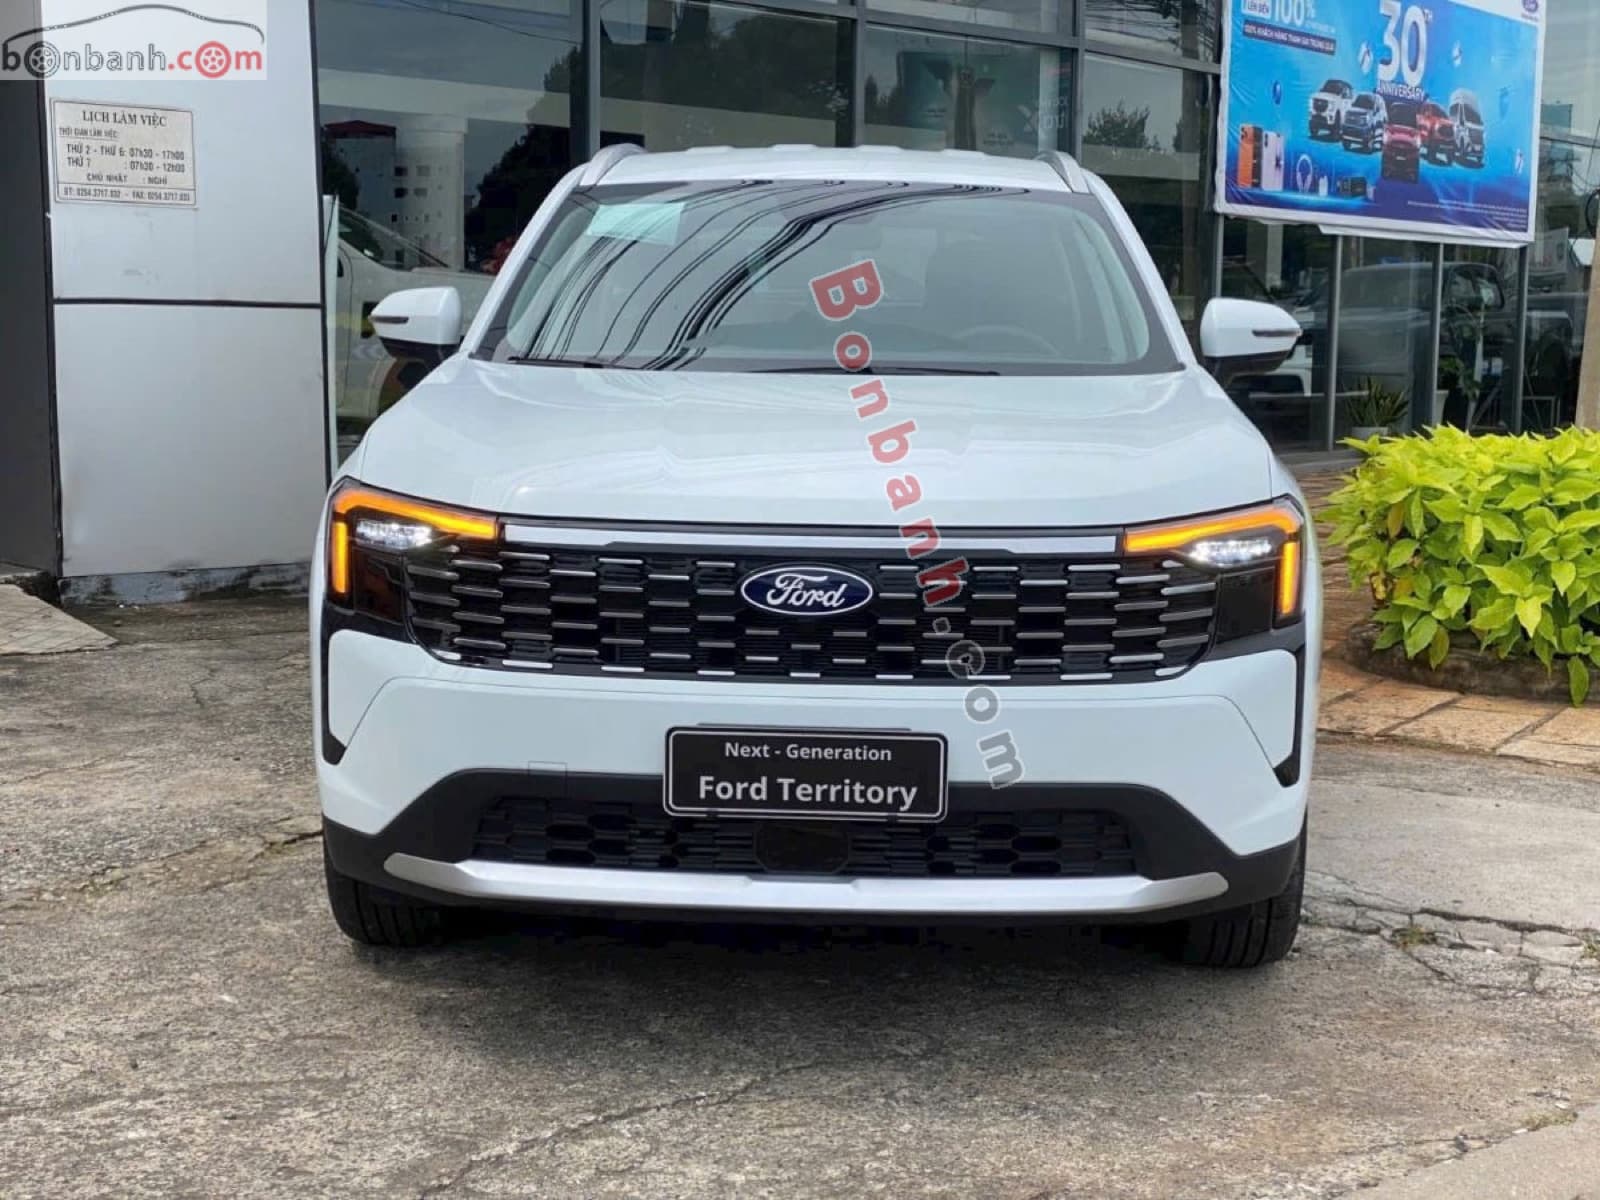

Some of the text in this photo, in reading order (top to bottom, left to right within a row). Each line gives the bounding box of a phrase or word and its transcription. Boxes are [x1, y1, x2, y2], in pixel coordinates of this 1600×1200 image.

[82, 110, 167, 128] LỊCH LÀM VIỆC
[67, 142, 84, 154] THỨ
[86, 144, 91, 156] 2
[100, 144, 116, 157] THỨ
[765, 572, 846, 609] Ford
[724, 741, 771, 759] Next
[785, 742, 893, 762] Generation
[698, 775, 919, 811] Ford Territory
